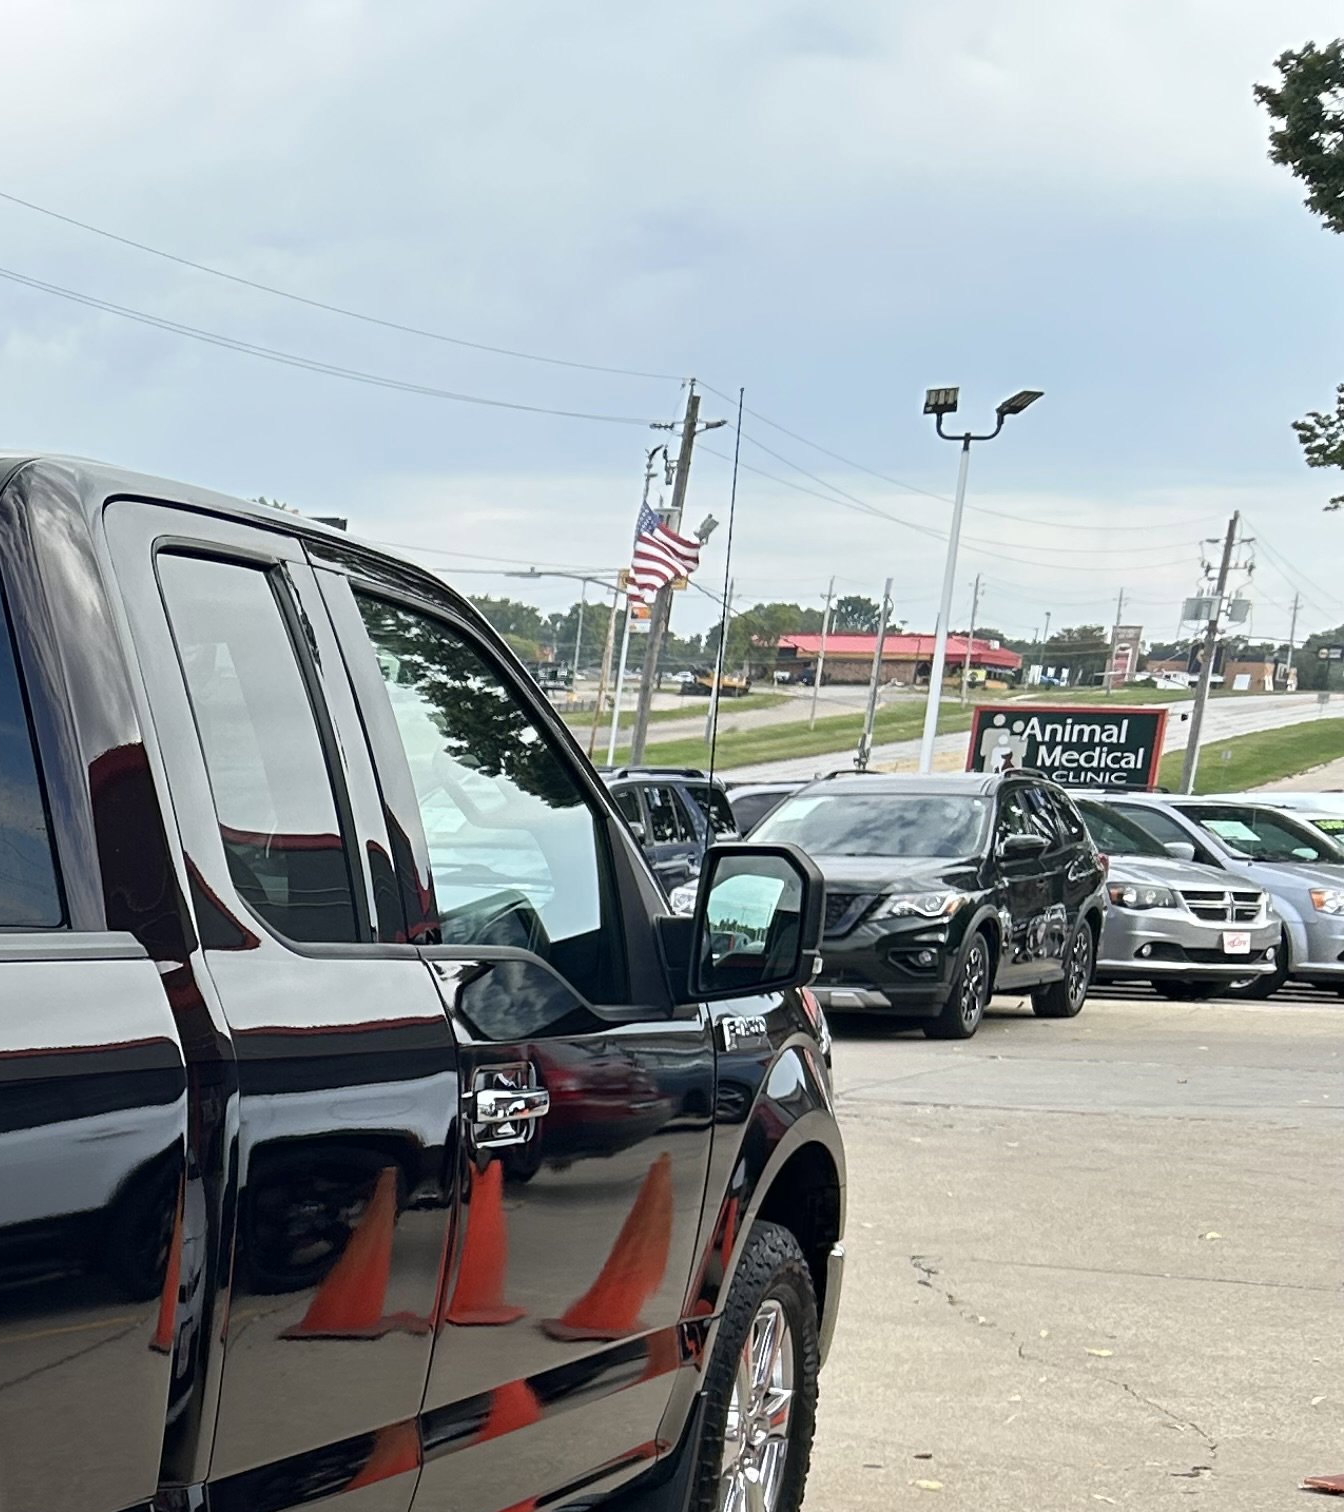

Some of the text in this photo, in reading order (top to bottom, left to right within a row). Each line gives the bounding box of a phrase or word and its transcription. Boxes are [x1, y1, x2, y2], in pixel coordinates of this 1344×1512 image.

[1021, 717, 1128, 744] Animal
[1036, 745, 1145, 769] Medical
[1052, 771, 1128, 784] CLINIC
